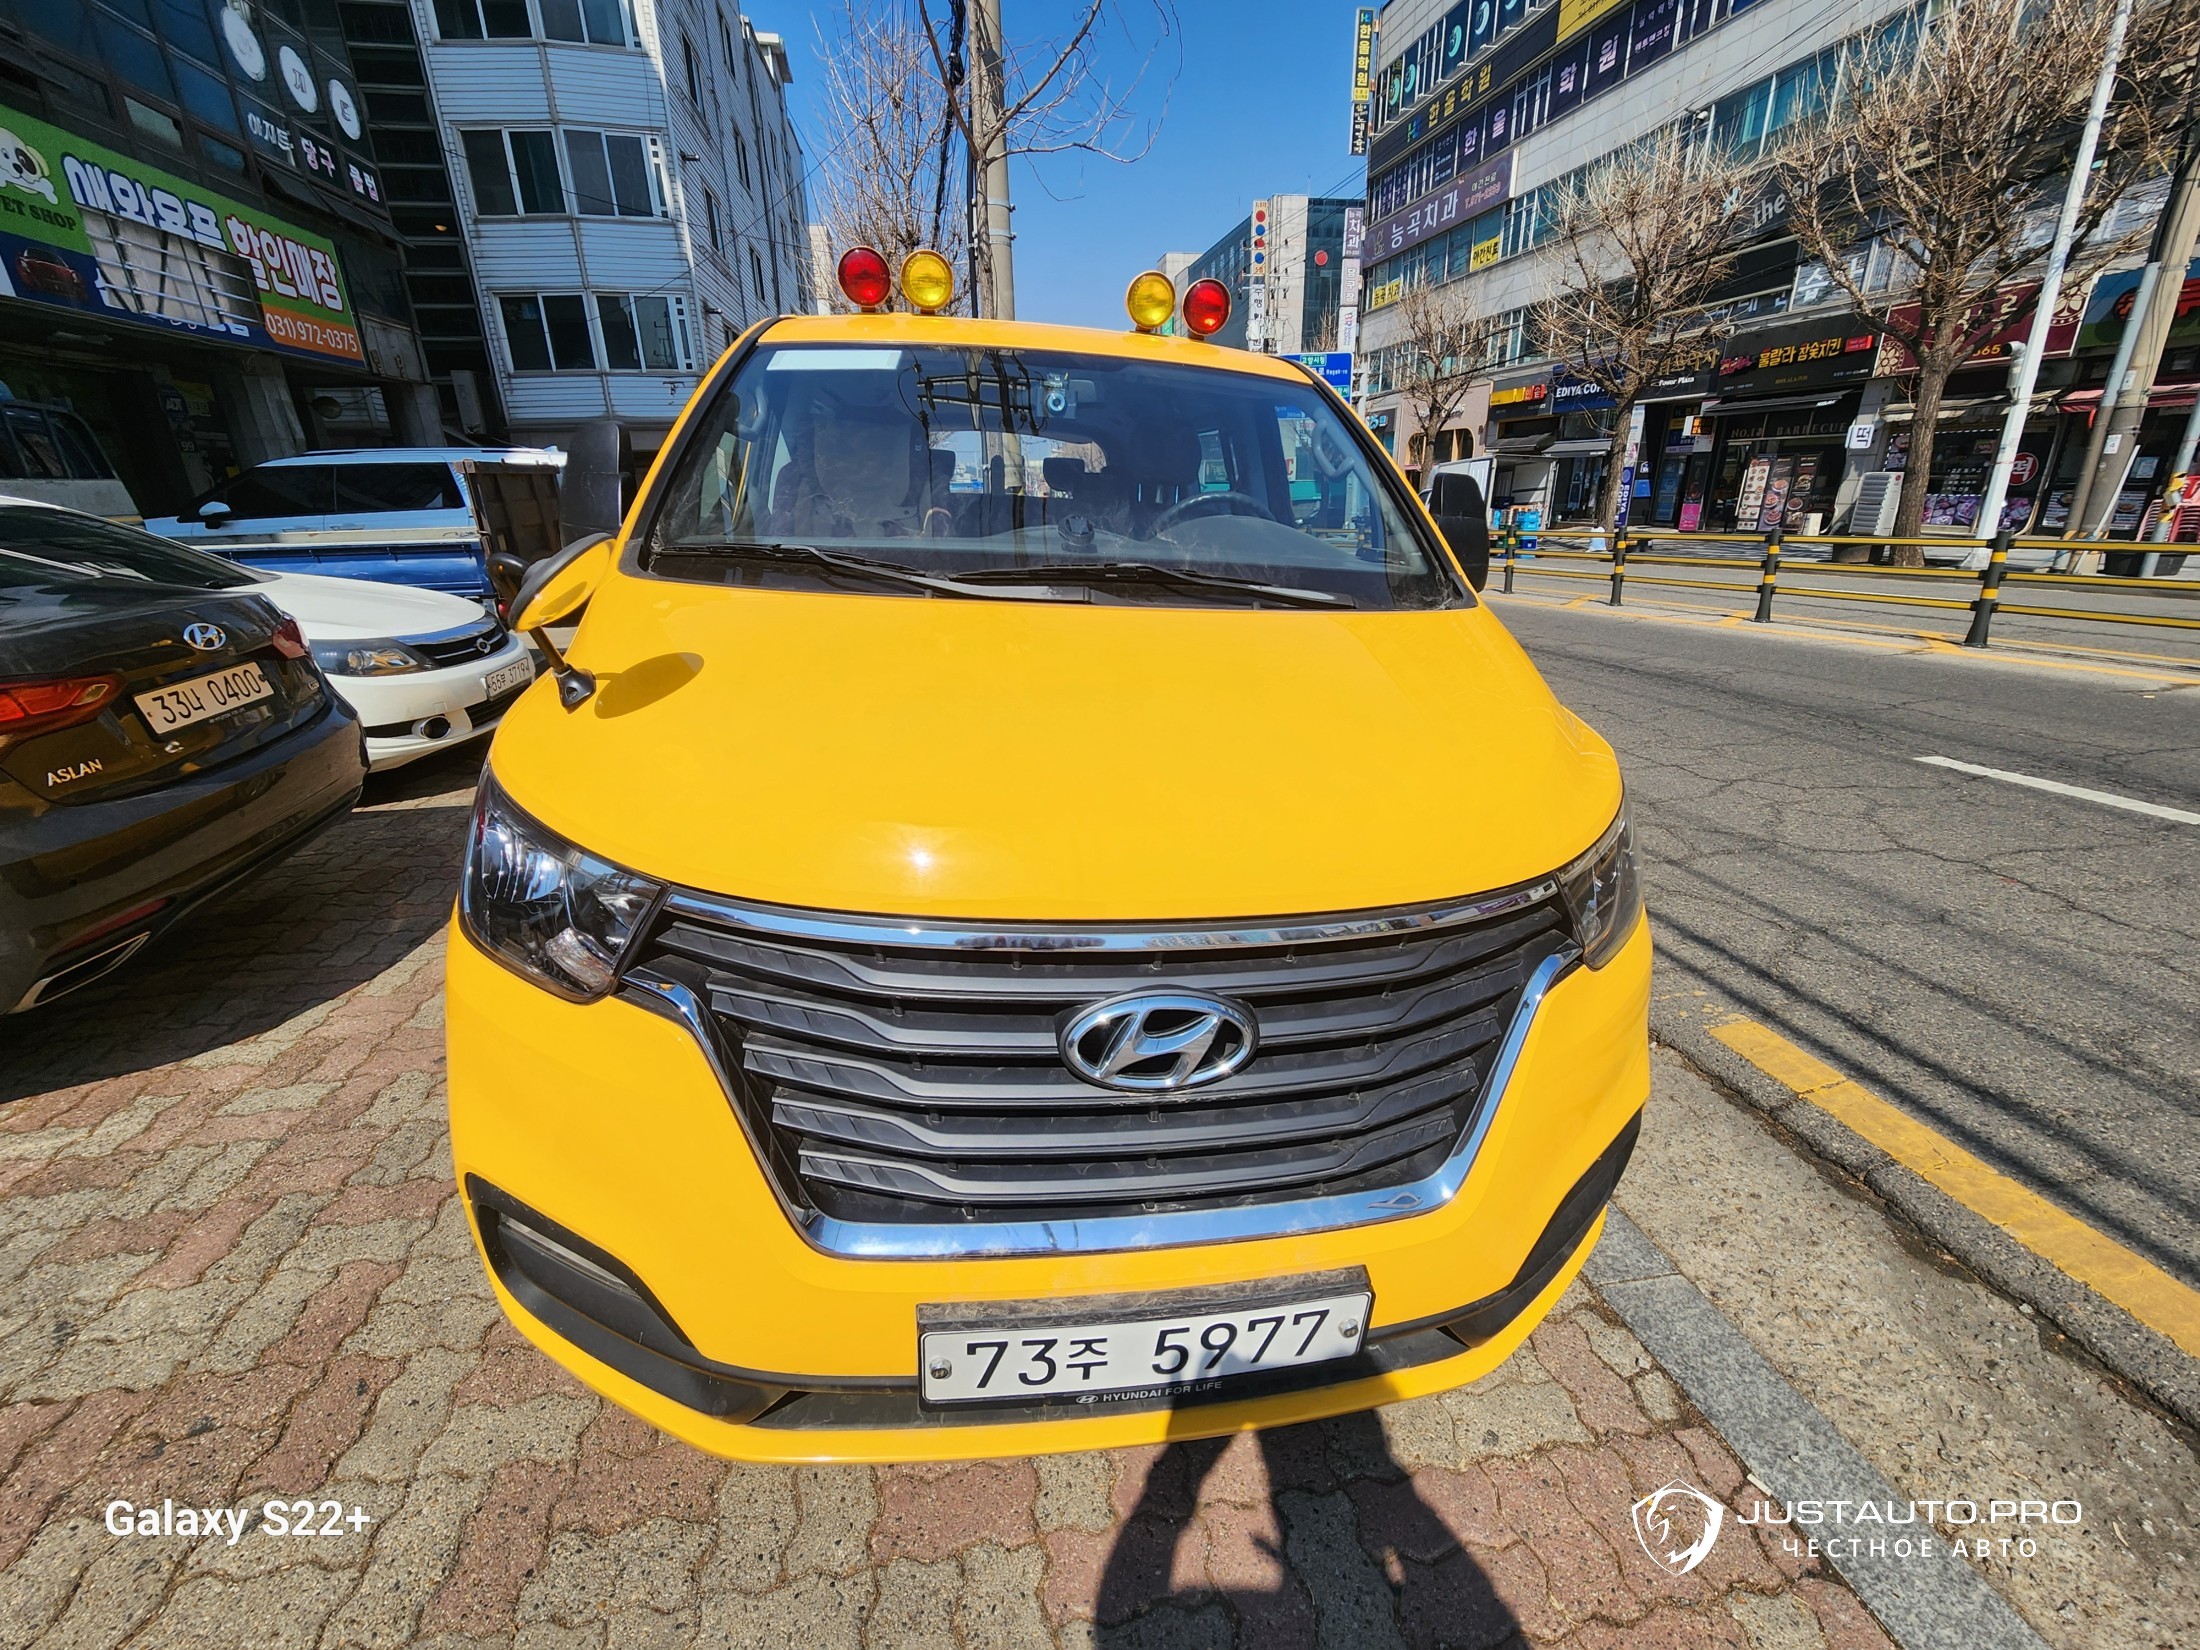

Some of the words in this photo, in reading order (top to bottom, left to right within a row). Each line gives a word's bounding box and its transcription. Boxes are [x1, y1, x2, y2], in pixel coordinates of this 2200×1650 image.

[1428, 63, 1492, 129] 한울학원
[301, 136, 337, 178] 당구
[0, 194, 26, 217] ET
[29, 205, 77, 232] SHOP
[1391, 188, 1459, 249] 능곡치과
[1347, 218, 1361, 249] 치과
[225, 213, 345, 313] 할인매장
[264, 312, 359, 354] 031)972-0375
[1758, 345, 1796, 369] 훌랄라
[1797, 337, 1842, 362] 참숯치킨
[1556, 384, 1582, 398] EDIYA
[1777, 421, 1847, 435] BARBECUE
[508, 662, 526, 684] 3719
[152, 688, 206, 724] 33나
[207, 669, 261, 706] 0400
[47, 758, 104, 787] ASLAN
[966, 1337, 1109, 1389] 73주
[1151, 1309, 1331, 1375] 5977
[1103, 1389, 1162, 1402] HYUNDAI
[1165, 1385, 1191, 1397] FOR
[1195, 1380, 1222, 1394] LIFE
